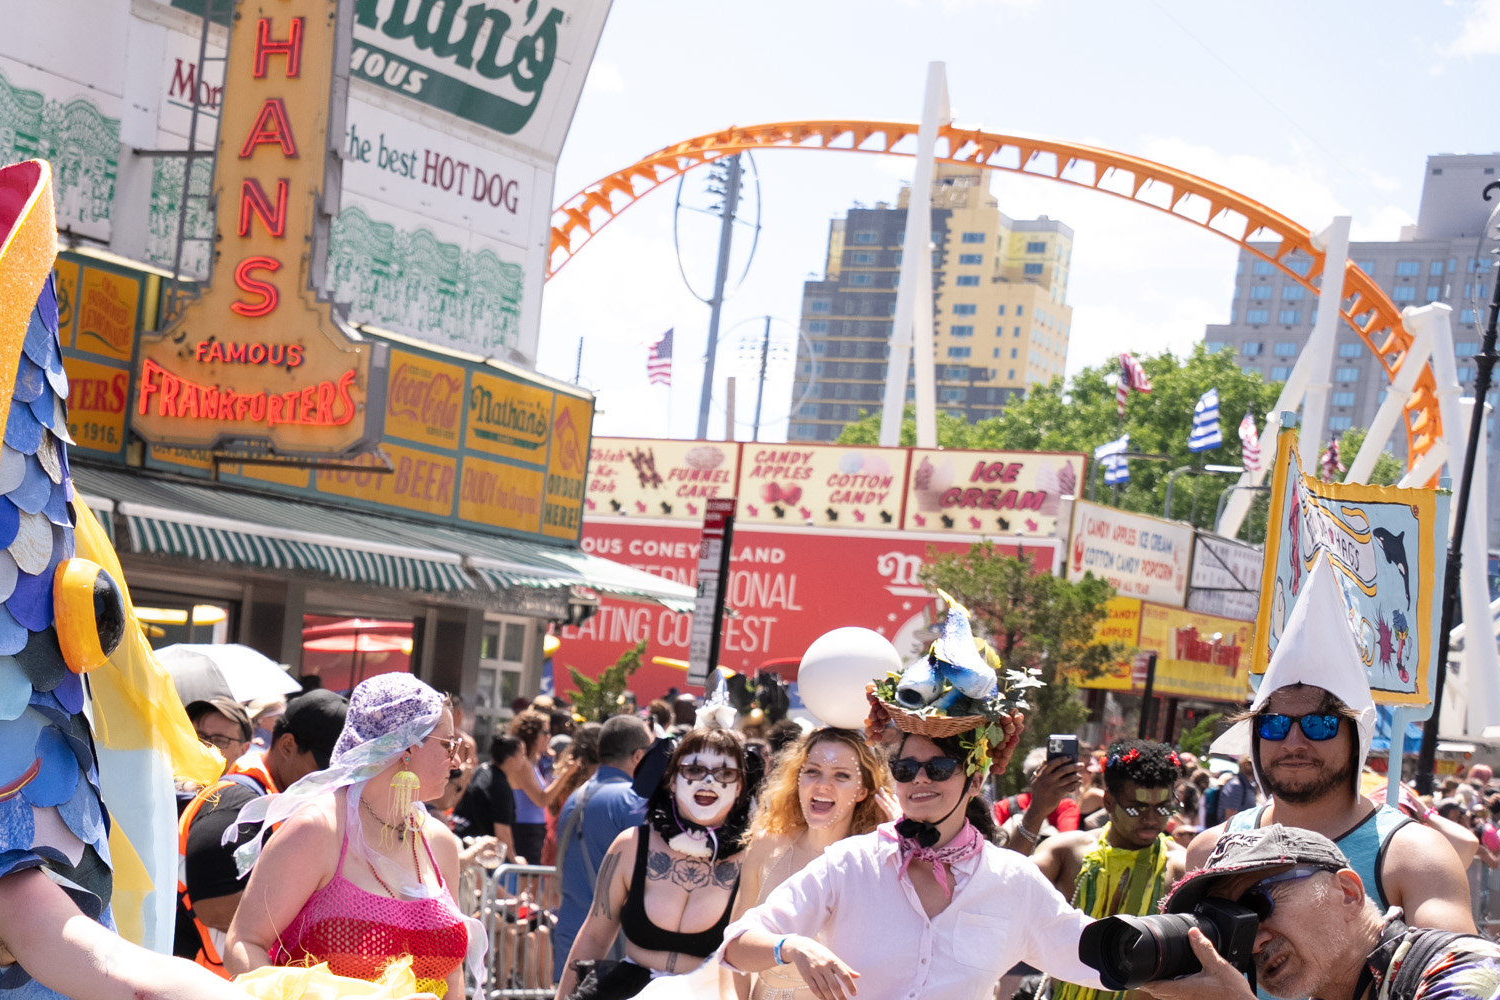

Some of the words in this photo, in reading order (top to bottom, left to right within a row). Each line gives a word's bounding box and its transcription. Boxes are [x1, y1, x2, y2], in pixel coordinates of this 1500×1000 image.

[350, 47, 429, 94] MOUS
[168, 58, 224, 111] Mor
[230, 16, 306, 318] HANS
[345, 124, 372, 164] he
[377, 133, 418, 180] best
[421, 148, 470, 197] HOT
[472, 167, 519, 215] DOG
[195, 341, 306, 367] FAMOUS
[138, 358, 357, 427] FRANKFURTERS
[470, 384, 548, 438] Nathan's
[754, 450, 815, 465] CANDY
[394, 455, 455, 504] BEER
[667, 468, 731, 484] FUNNEL
[750, 464, 815, 480] APPLES
[826, 473, 894, 489] COTTON
[970, 460, 1024, 484] ICE
[548, 473, 583, 499] ORDER
[676, 484, 720, 499] CAKE
[828, 490, 890, 506] CANDY
[940, 486, 1048, 512] CREAM
[545, 502, 580, 531] HERE!
[580, 536, 623, 555] OUS
[628, 538, 701, 559] CONEY
[1087, 517, 1111, 540] CANDY
[1112, 524, 1138, 547] APPLES
[1151, 532, 1174, 555] CREAM
[1085, 546, 1115, 569] COTTON
[1117, 552, 1141, 575] CANDY
[1141, 559, 1173, 581] POPCORN
[657, 607, 779, 654] COEST
